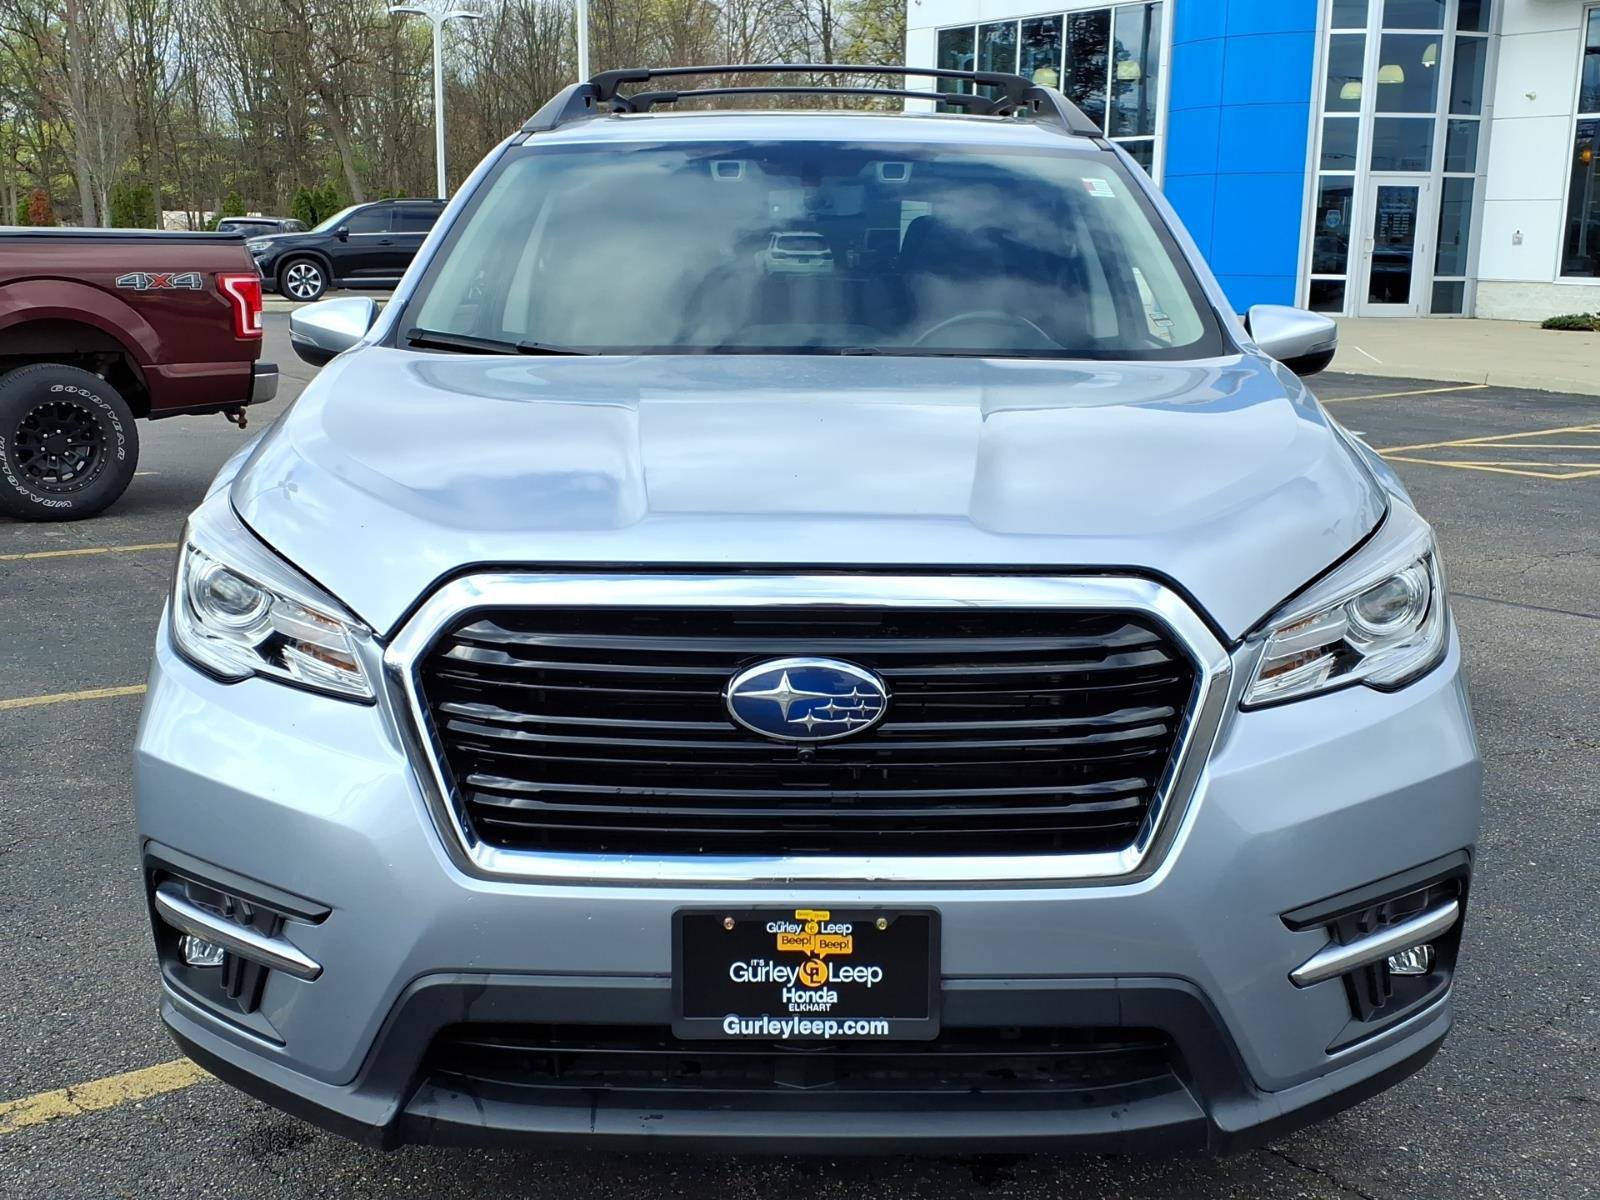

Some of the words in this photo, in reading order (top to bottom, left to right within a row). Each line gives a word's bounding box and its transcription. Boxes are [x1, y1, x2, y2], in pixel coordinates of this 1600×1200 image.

[821, 922, 852, 936] Leep
[782, 935, 811, 947] Beep!
[820, 939, 849, 951] Beep!
[729, 960, 800, 987] Gurley
[828, 961, 883, 988] Leep
[782, 986, 838, 1003] Honda
[788, 1003, 831, 1012] ELKHART
[723, 1015, 889, 1039] Gurleyleep.com
